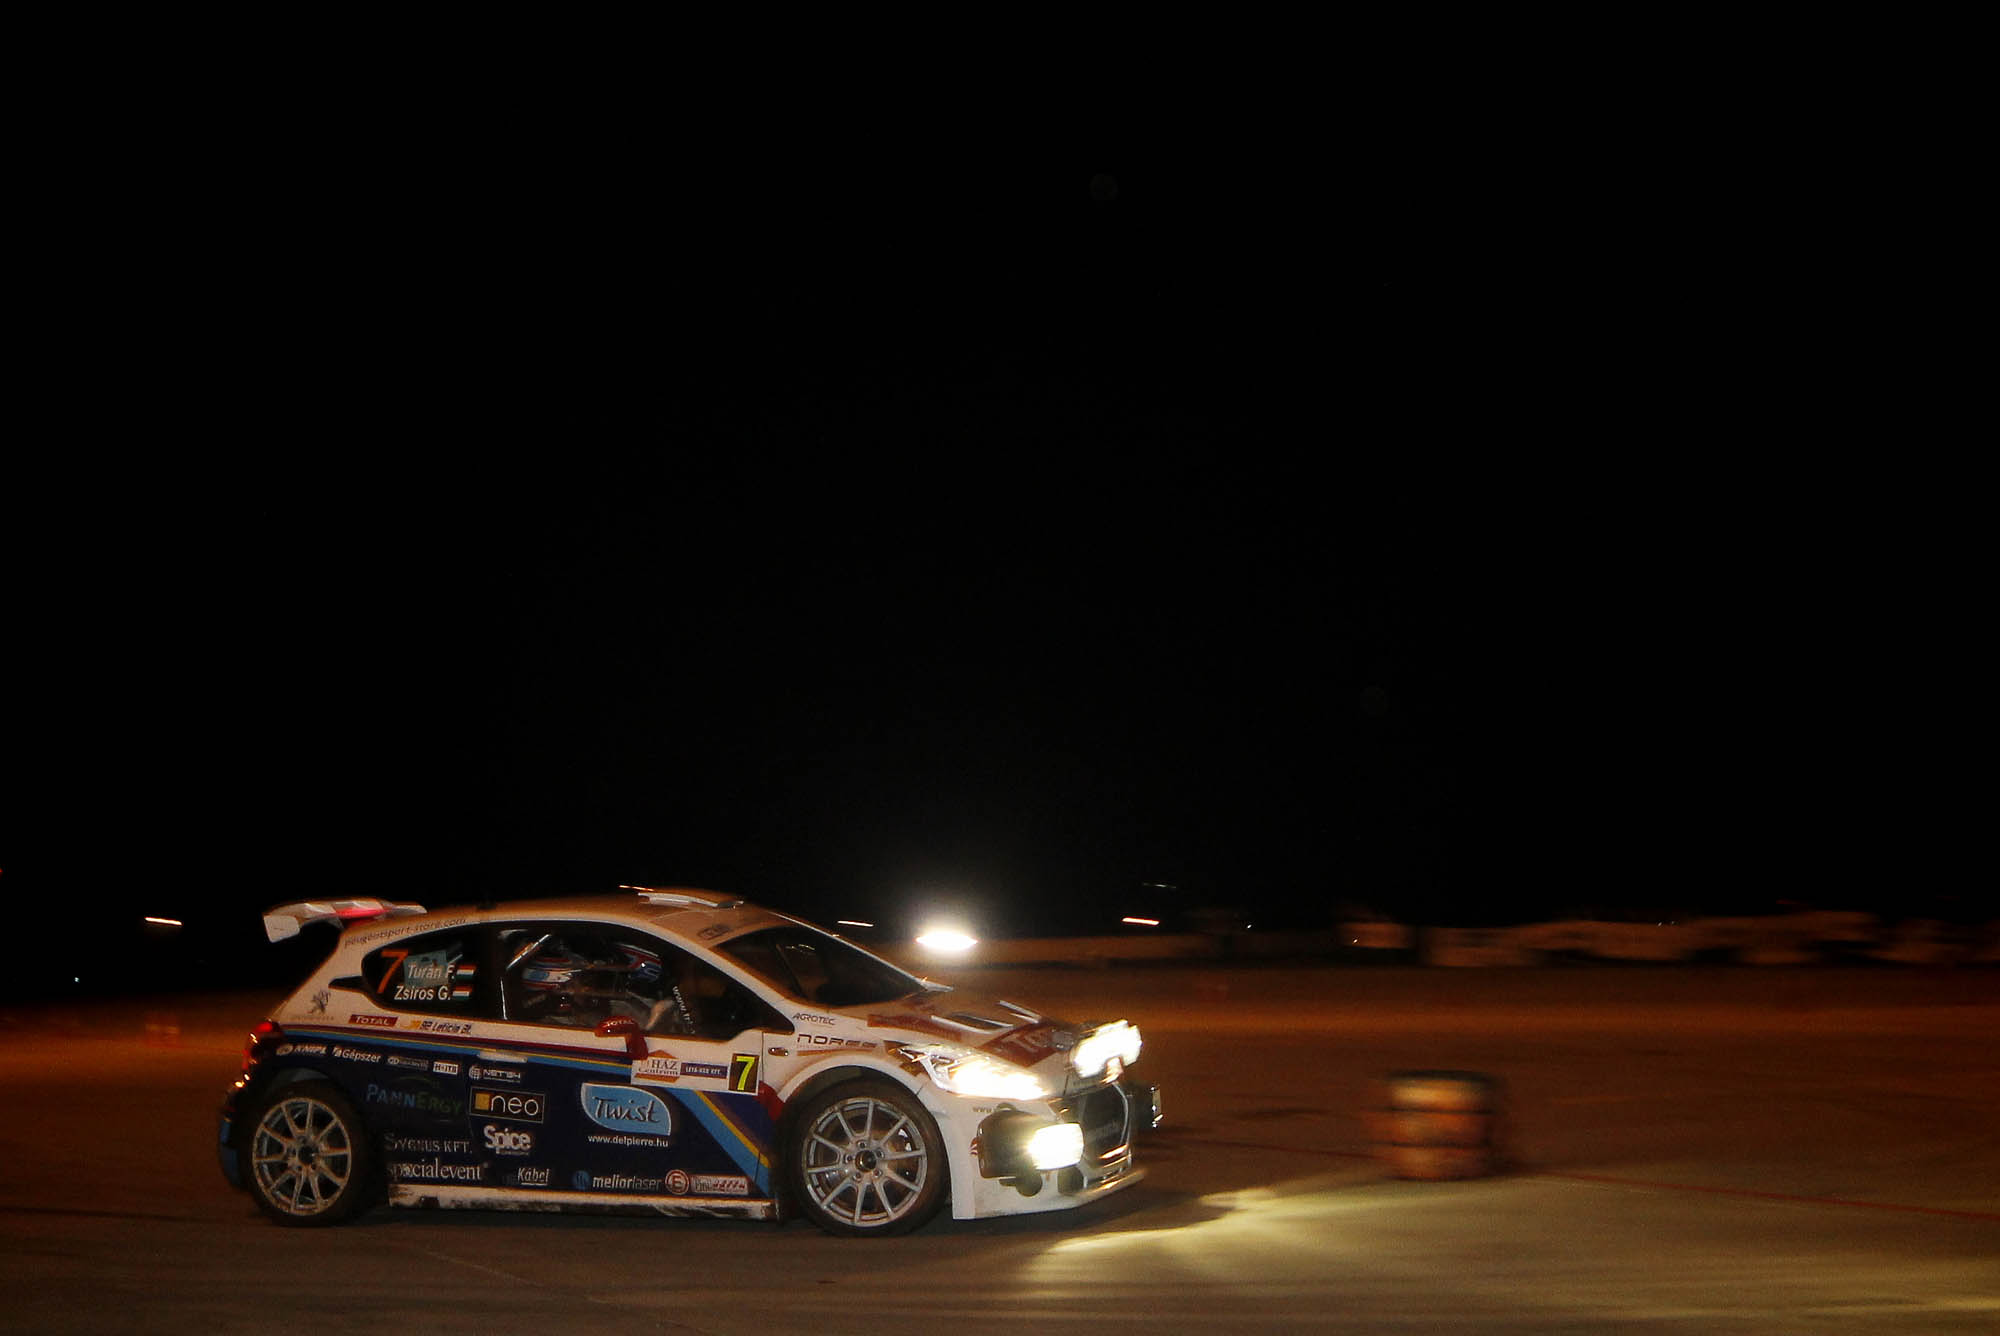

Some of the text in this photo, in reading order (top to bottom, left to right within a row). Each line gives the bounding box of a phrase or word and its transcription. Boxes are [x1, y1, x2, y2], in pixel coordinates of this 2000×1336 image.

[376, 949, 408, 993] 7
[407, 963, 442, 980] Turán
[437, 985, 451, 1001] G.
[355, 1016, 391, 1026] TOTAL
[793, 1013, 836, 1026] AGROTEC
[342, 1049, 381, 1063] Gépszer
[734, 1055, 755, 1091] 7
[490, 1095, 539, 1116] neo
[592, 1096, 660, 1124] Twist
[444, 1141, 473, 1154] KFT.
[483, 1124, 534, 1156] Spice
[588, 1134, 669, 1148] www.delpierre.hu
